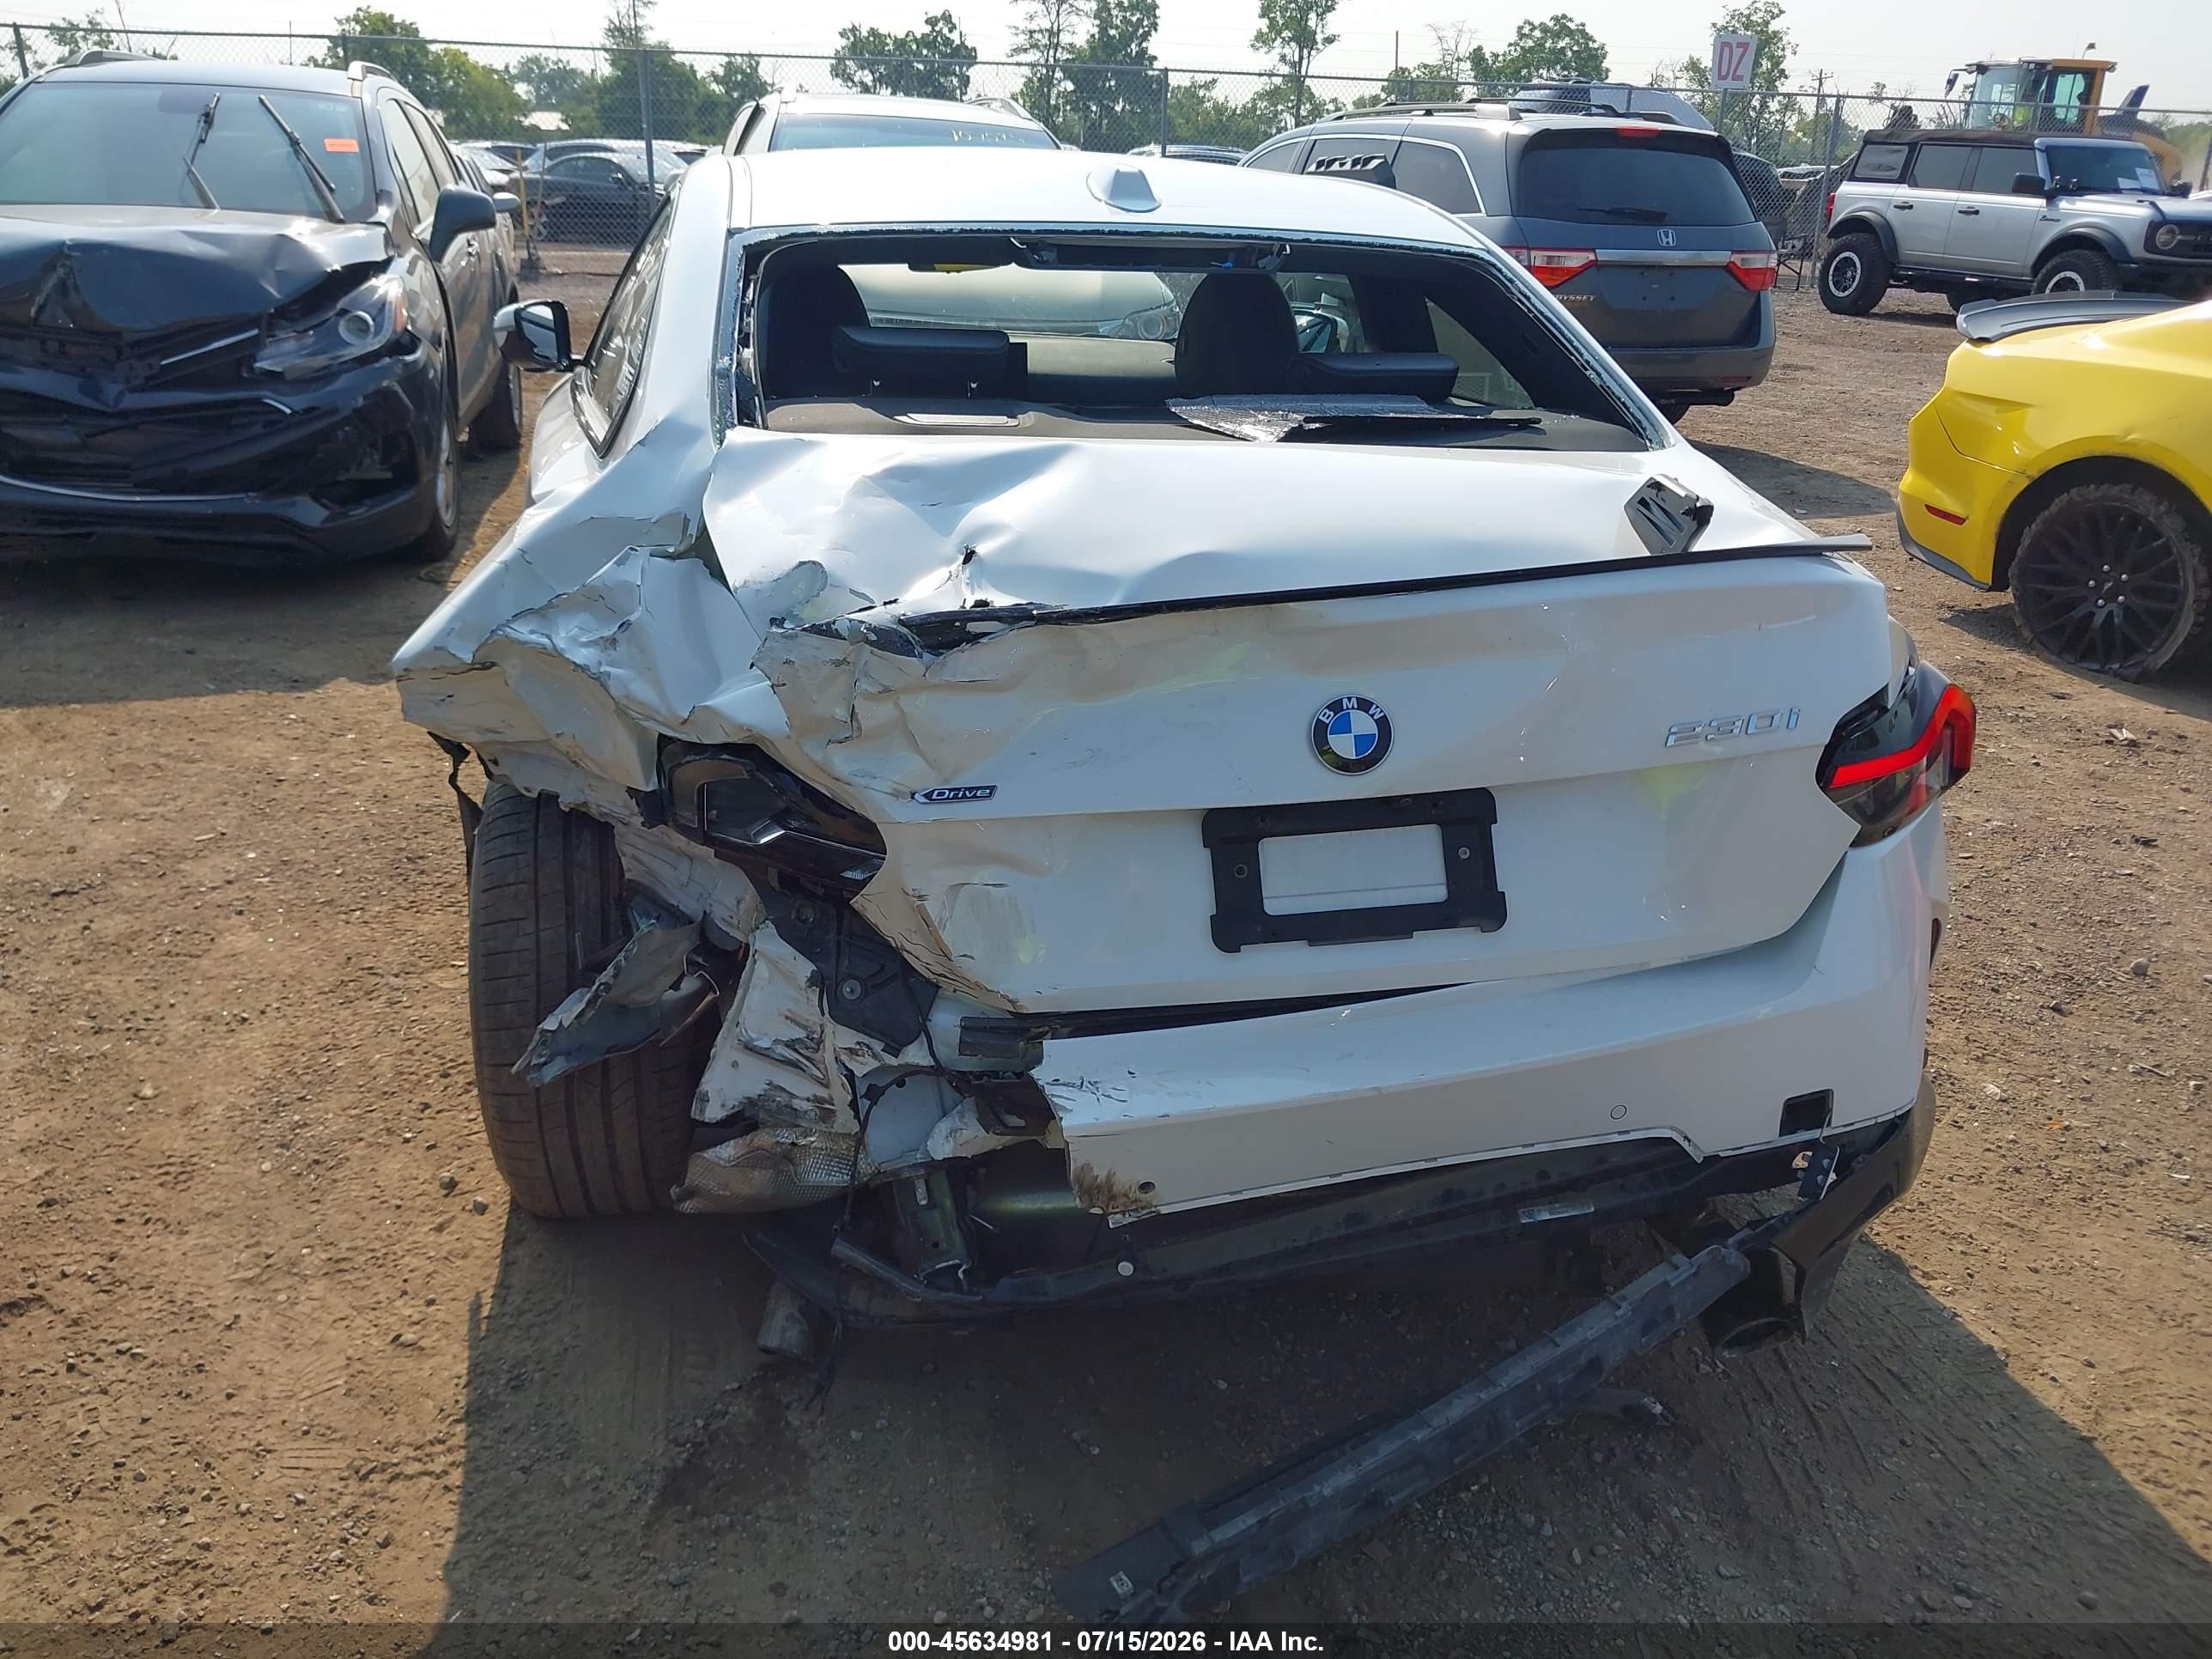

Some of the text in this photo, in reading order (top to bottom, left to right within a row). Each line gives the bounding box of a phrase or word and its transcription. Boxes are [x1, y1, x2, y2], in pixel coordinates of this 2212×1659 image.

[1717, 41, 1750, 82] DZ
[1318, 697, 1384, 724] BMW
[1665, 708, 1801, 748] 230i
